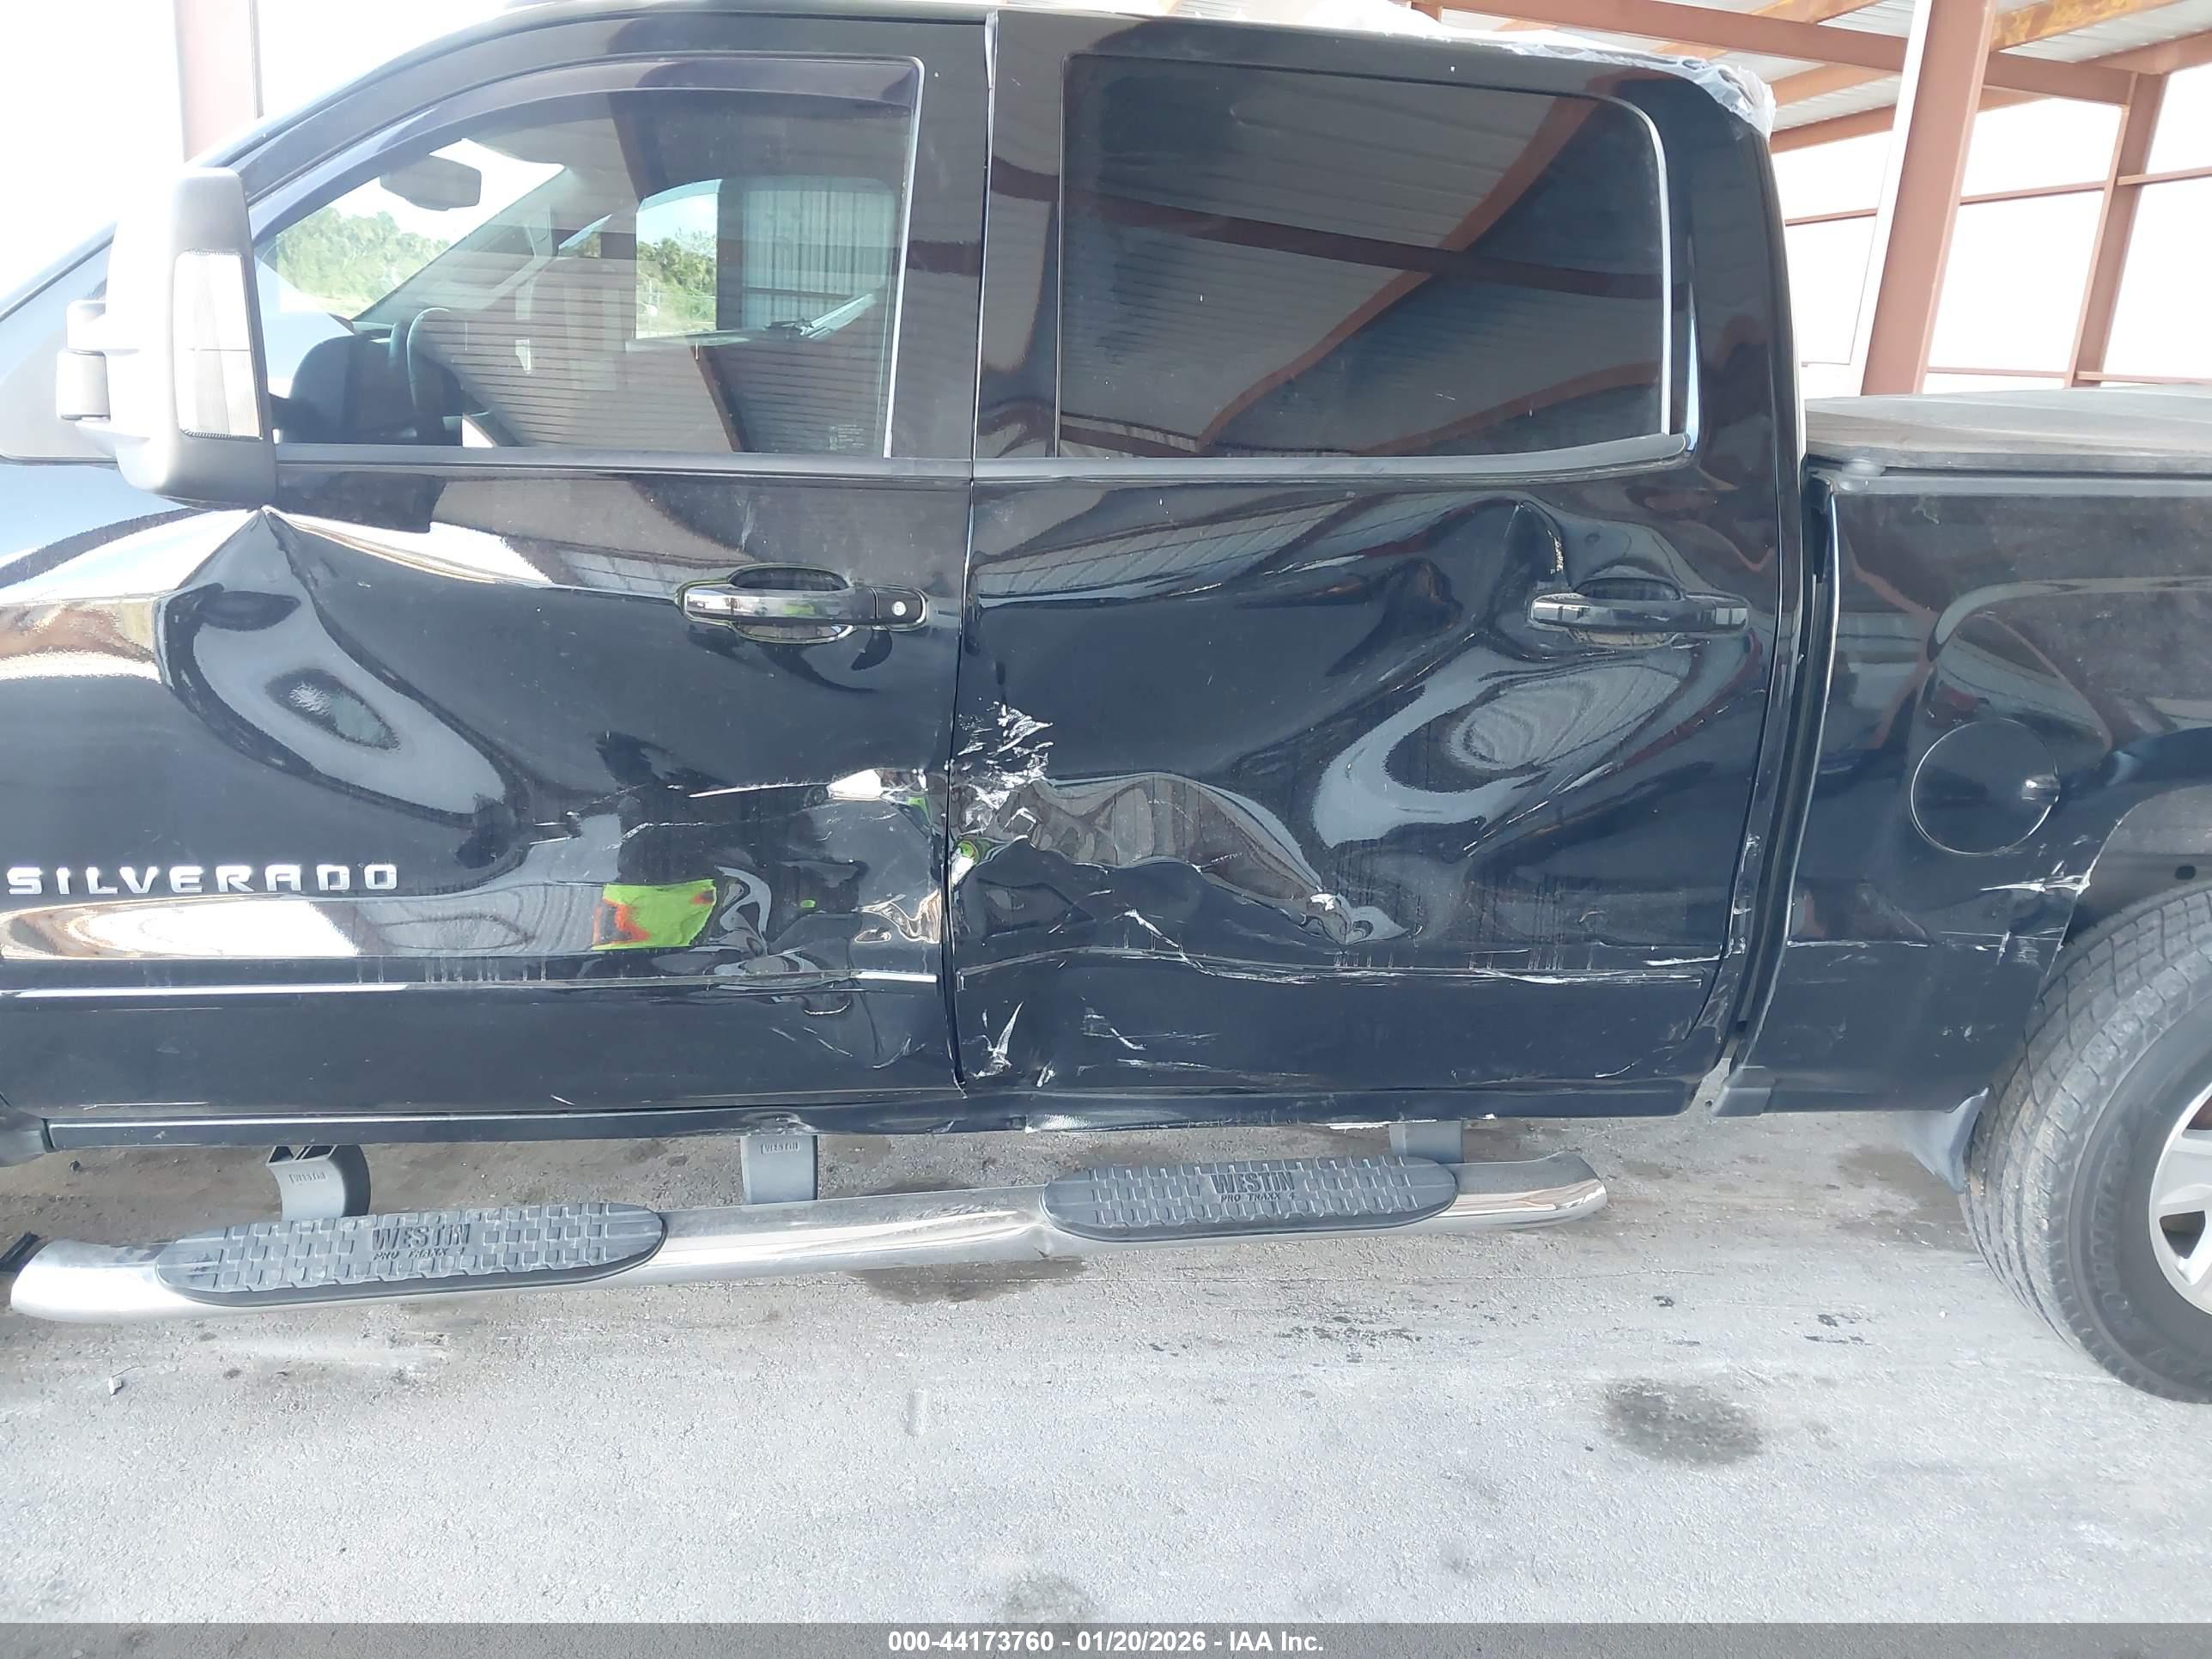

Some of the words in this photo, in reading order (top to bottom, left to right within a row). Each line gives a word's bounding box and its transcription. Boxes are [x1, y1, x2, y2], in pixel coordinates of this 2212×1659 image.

[7, 864, 398, 895] SILVERADO
[1210, 1171, 1295, 1194] WESTIN
[1220, 1194, 1241, 1202] PRO
[1247, 1192, 1280, 1201] TRAXX
[372, 1223, 471, 1250] WESTIN
[373, 1250, 399, 1261] PRO
